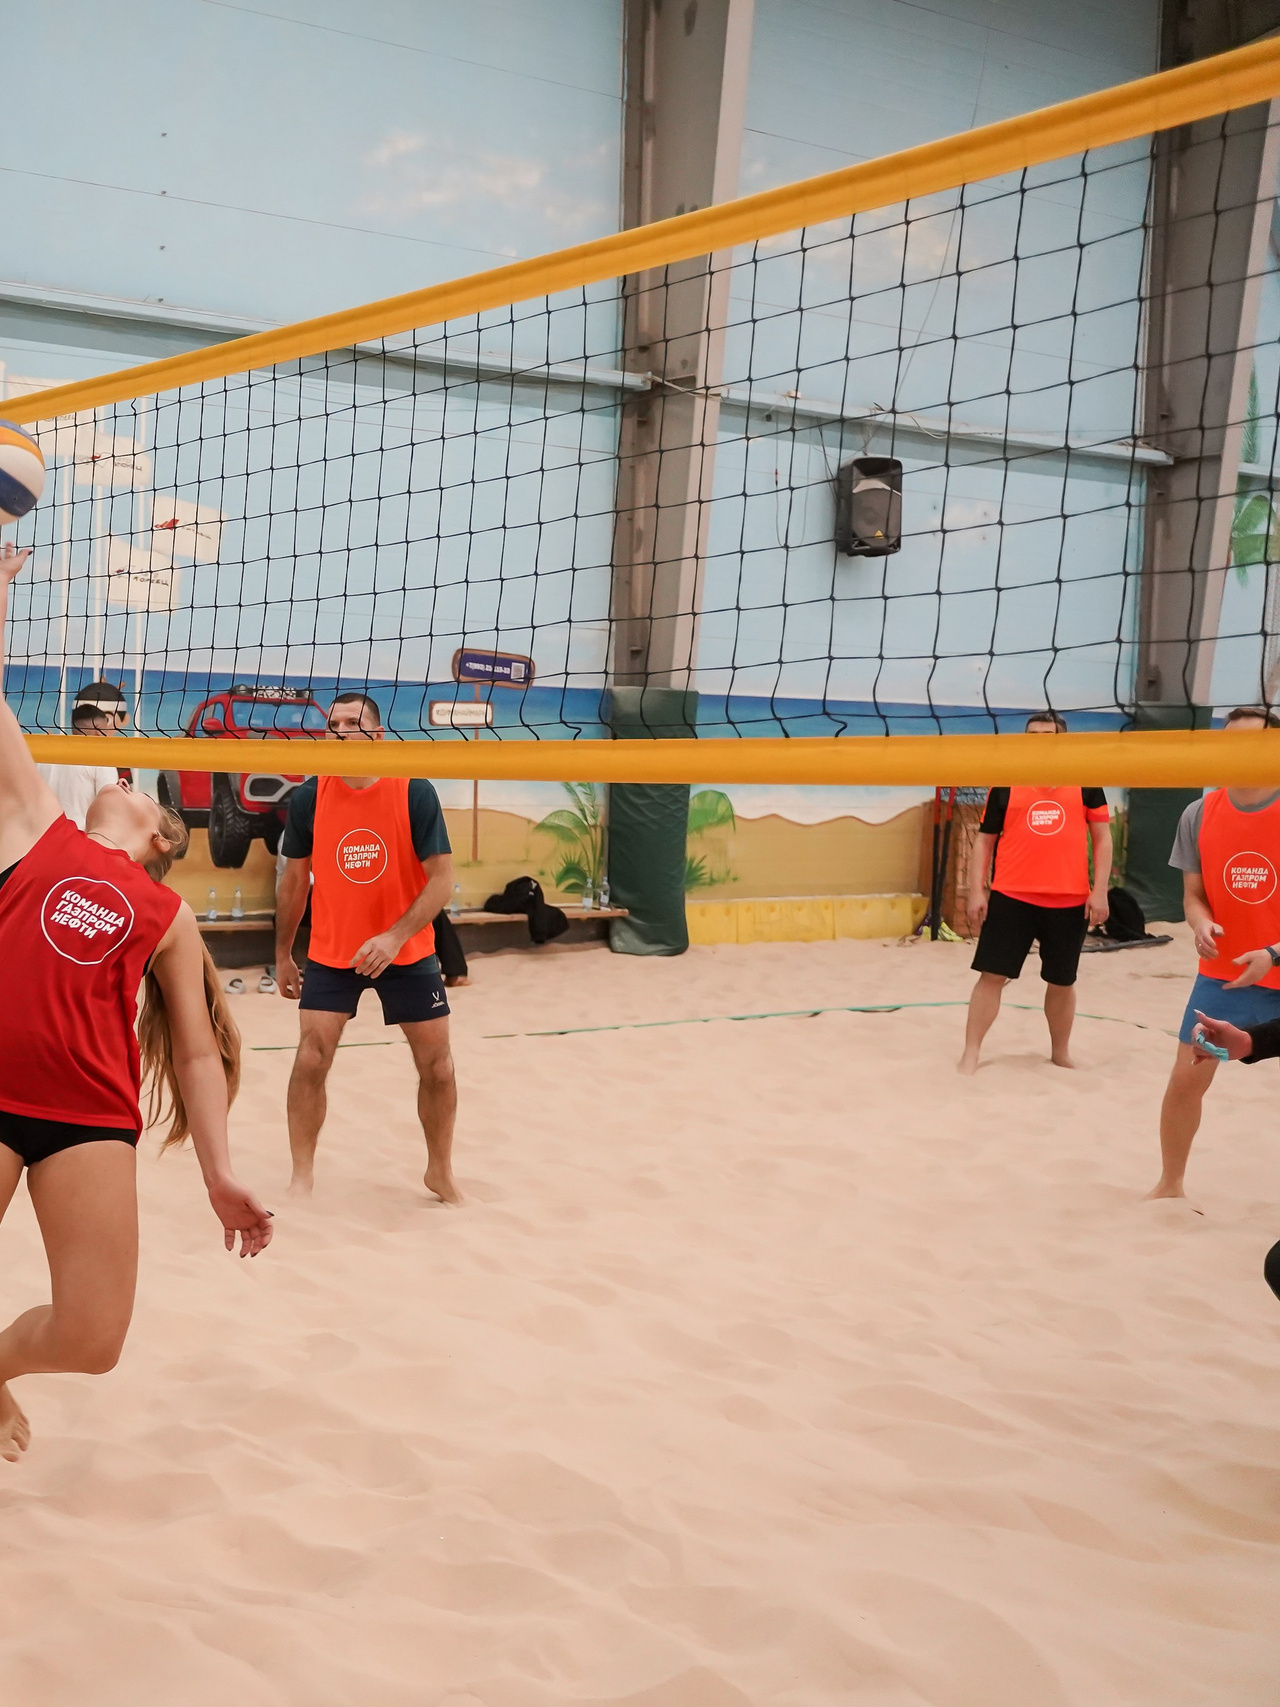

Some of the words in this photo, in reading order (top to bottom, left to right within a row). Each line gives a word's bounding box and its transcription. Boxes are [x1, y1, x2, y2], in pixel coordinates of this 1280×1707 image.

[343, 844, 380, 854] КОМАНДА
[344, 852, 378, 861] ГАЗПРОМ
[345, 860, 370, 869] НЕФТИ
[55, 900, 117, 935] ГАЗПРОМ
[61, 890, 125, 927] КОМАНДА
[50, 911, 98, 939] НЕФТИ
